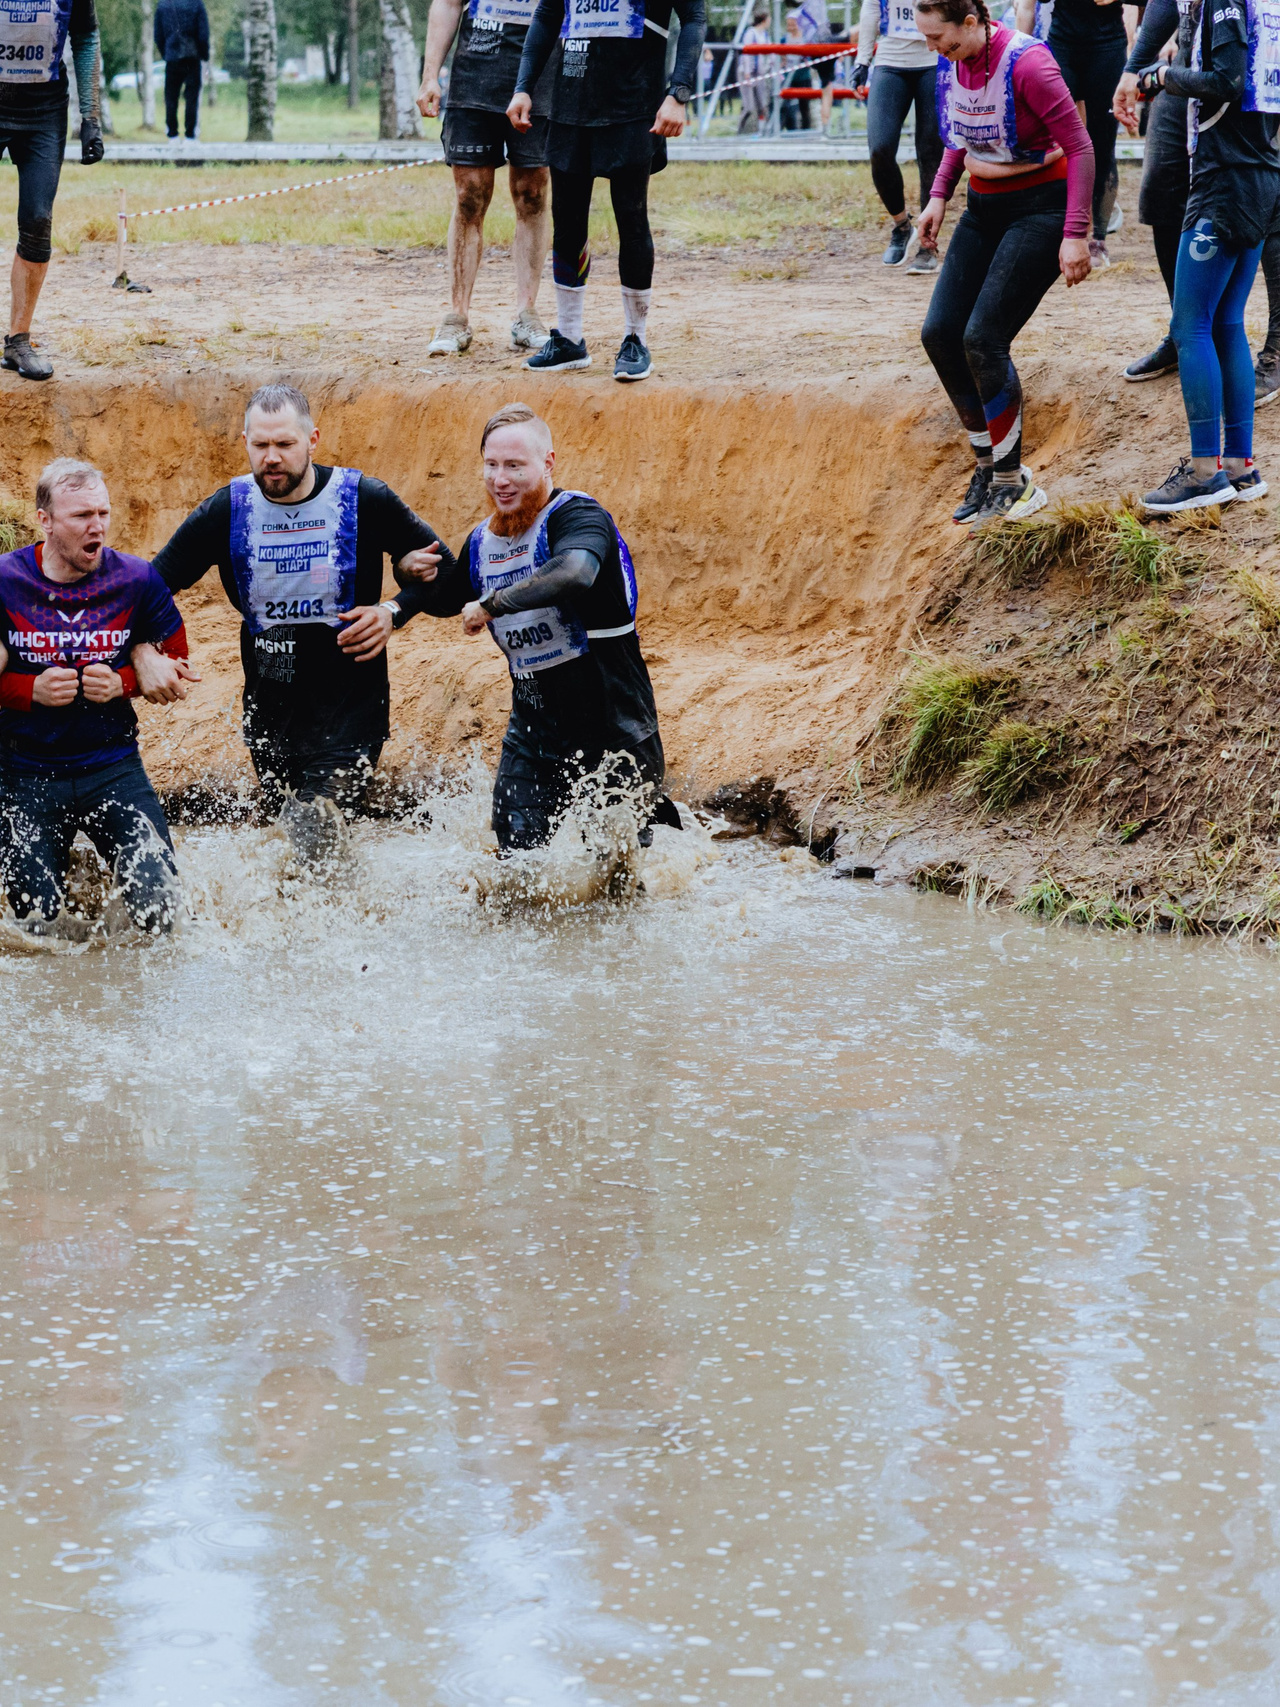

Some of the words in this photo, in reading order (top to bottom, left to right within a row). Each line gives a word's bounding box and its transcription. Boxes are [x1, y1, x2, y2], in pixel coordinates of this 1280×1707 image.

[576, 0, 619, 14] 23402
[11, 12, 36, 22] СТАРТ
[292, 519, 326, 529] ГЕРОЕВ
[259, 541, 328, 560] КОМАНДНЫЙ
[277, 559, 309, 572] СТАРТ
[265, 600, 324, 620] 23403
[8, 629, 131, 648] ИНСТРУКТОР
[260, 627, 296, 641] GNT
[505, 622, 554, 650] 23409
[255, 636, 296, 654] MGNT
[19, 651, 67, 663] ГОНКА
[523, 649, 563, 665] ГАЗПРОМБАНК
